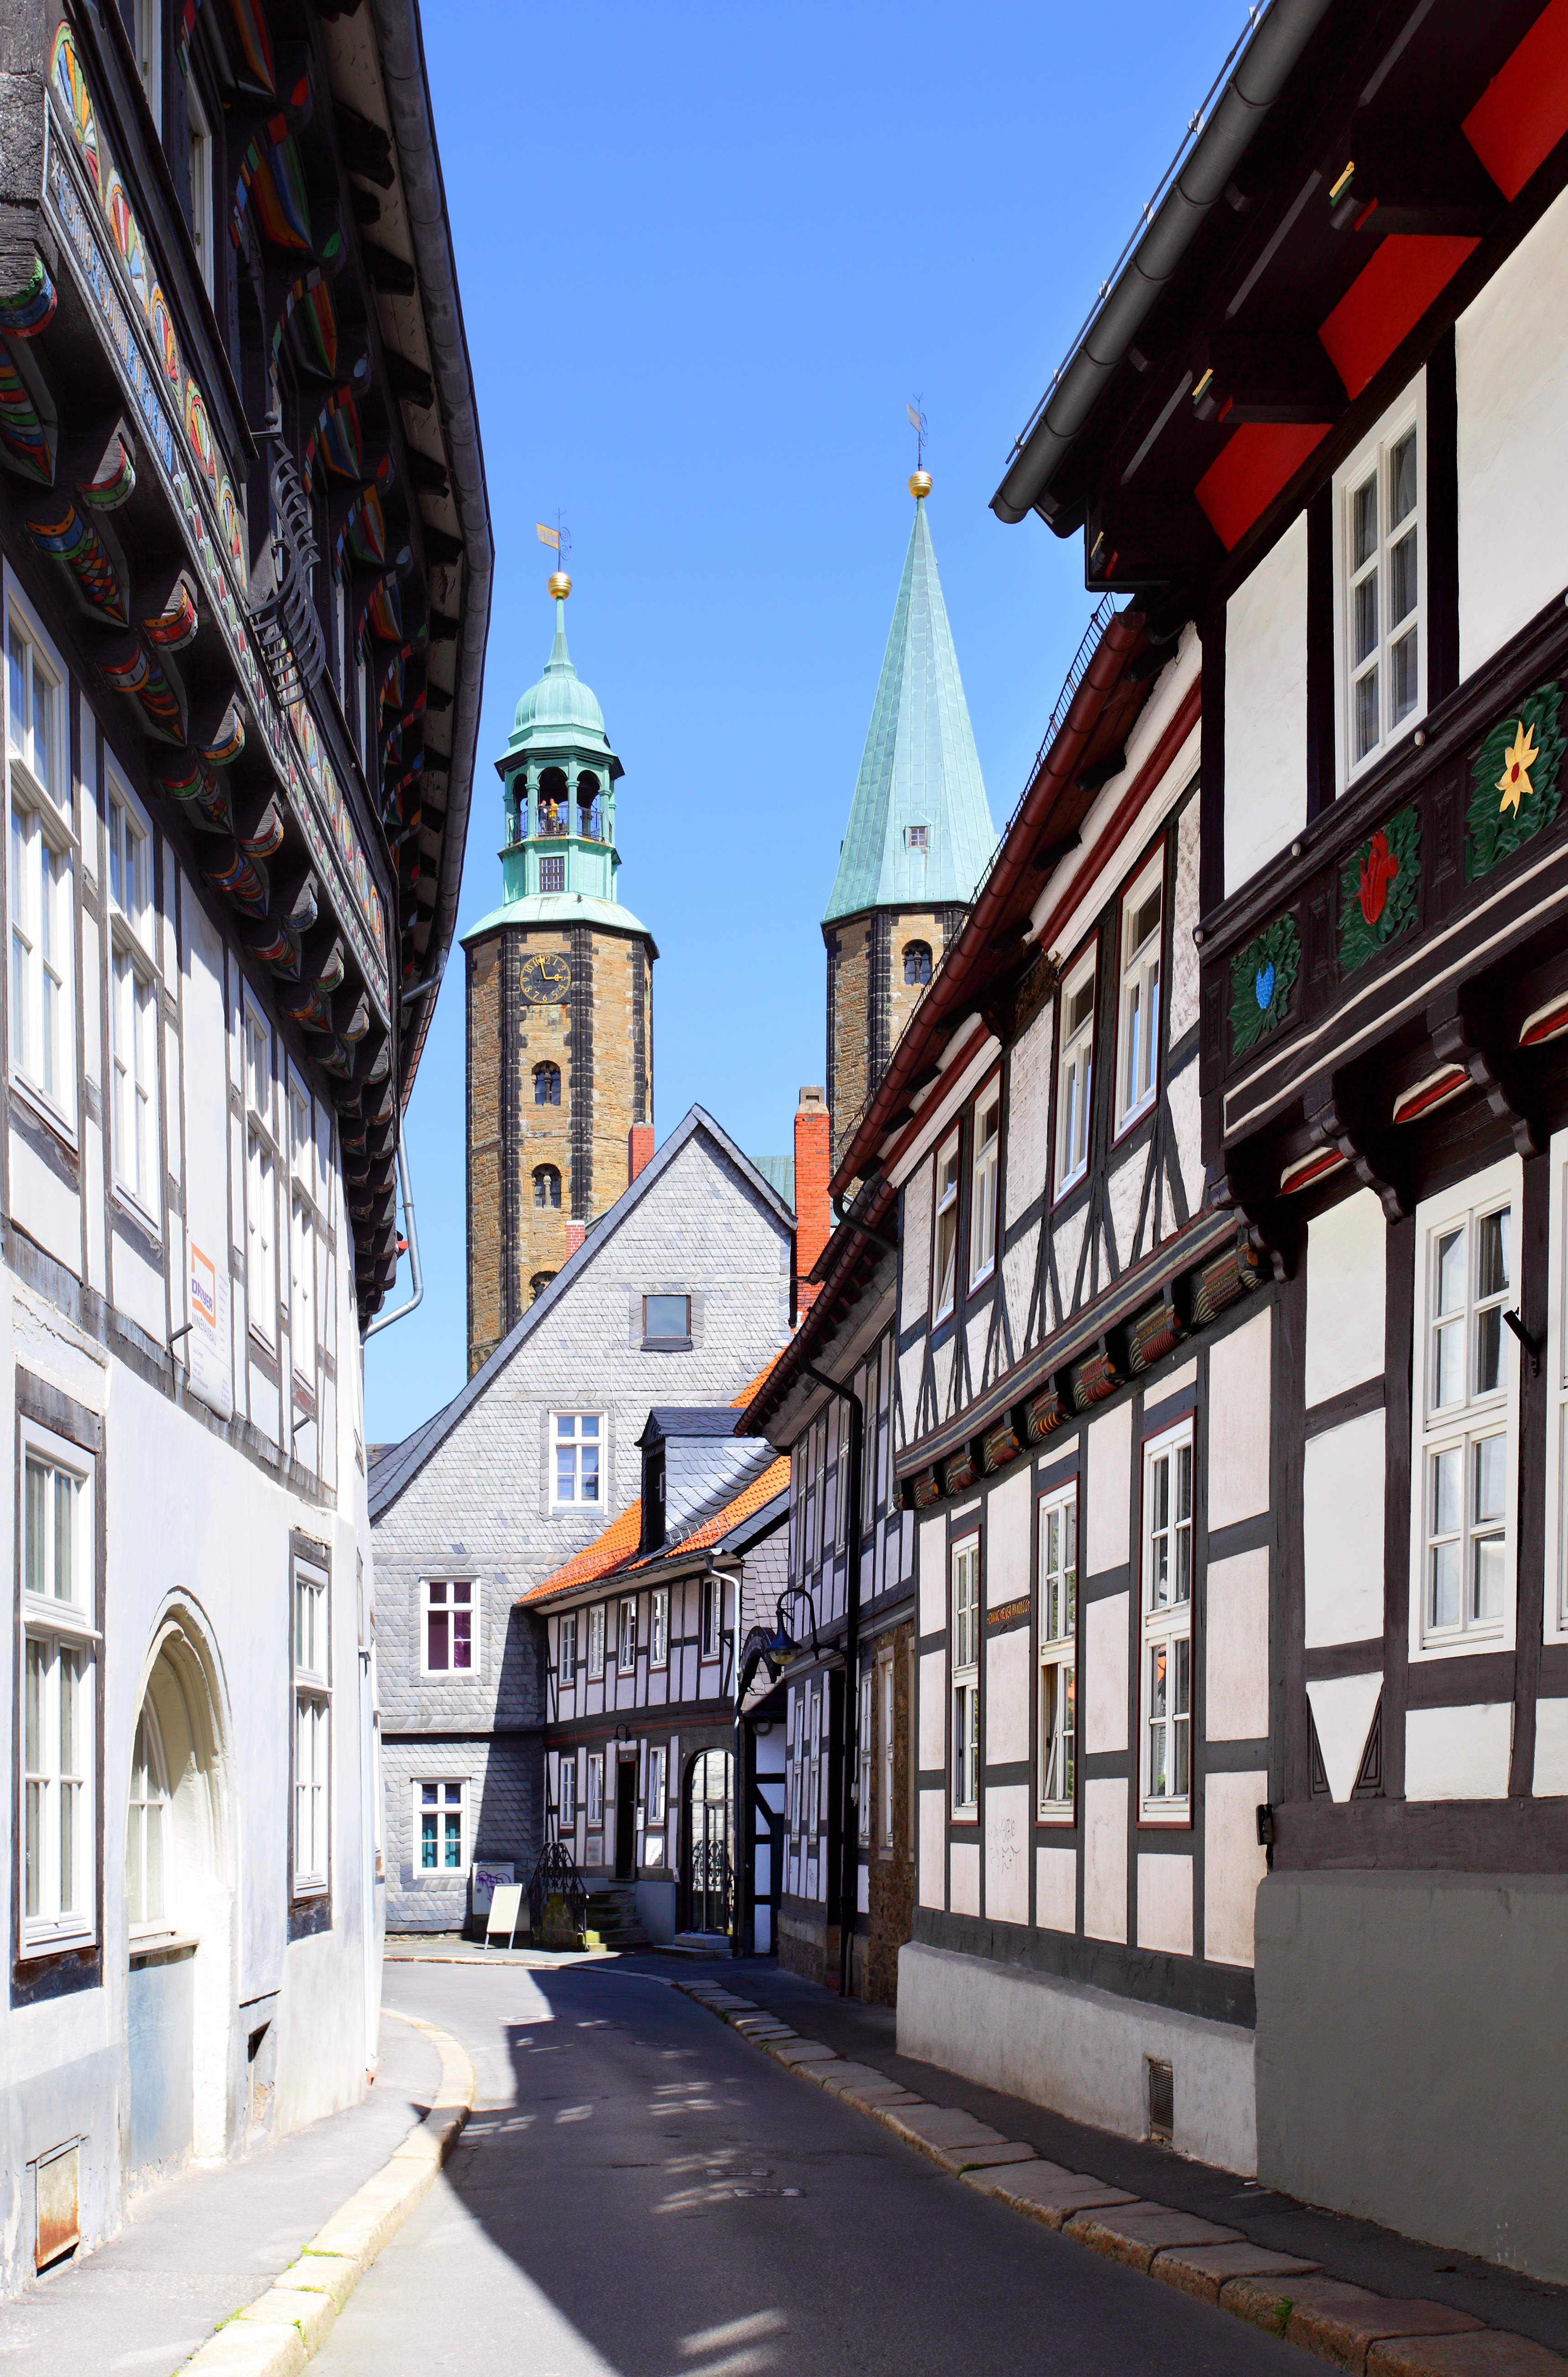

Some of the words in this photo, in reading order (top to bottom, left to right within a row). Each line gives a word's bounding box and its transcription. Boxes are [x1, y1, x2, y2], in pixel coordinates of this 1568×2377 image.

[532, 958, 540, 967] 11
[543, 956, 550, 964] 12
[525, 965, 534, 974] 10
[532, 990, 540, 999] 7
[192, 1278, 213, 1313] DREYER
[192, 1312, 217, 1345] INNENAUSBAU
